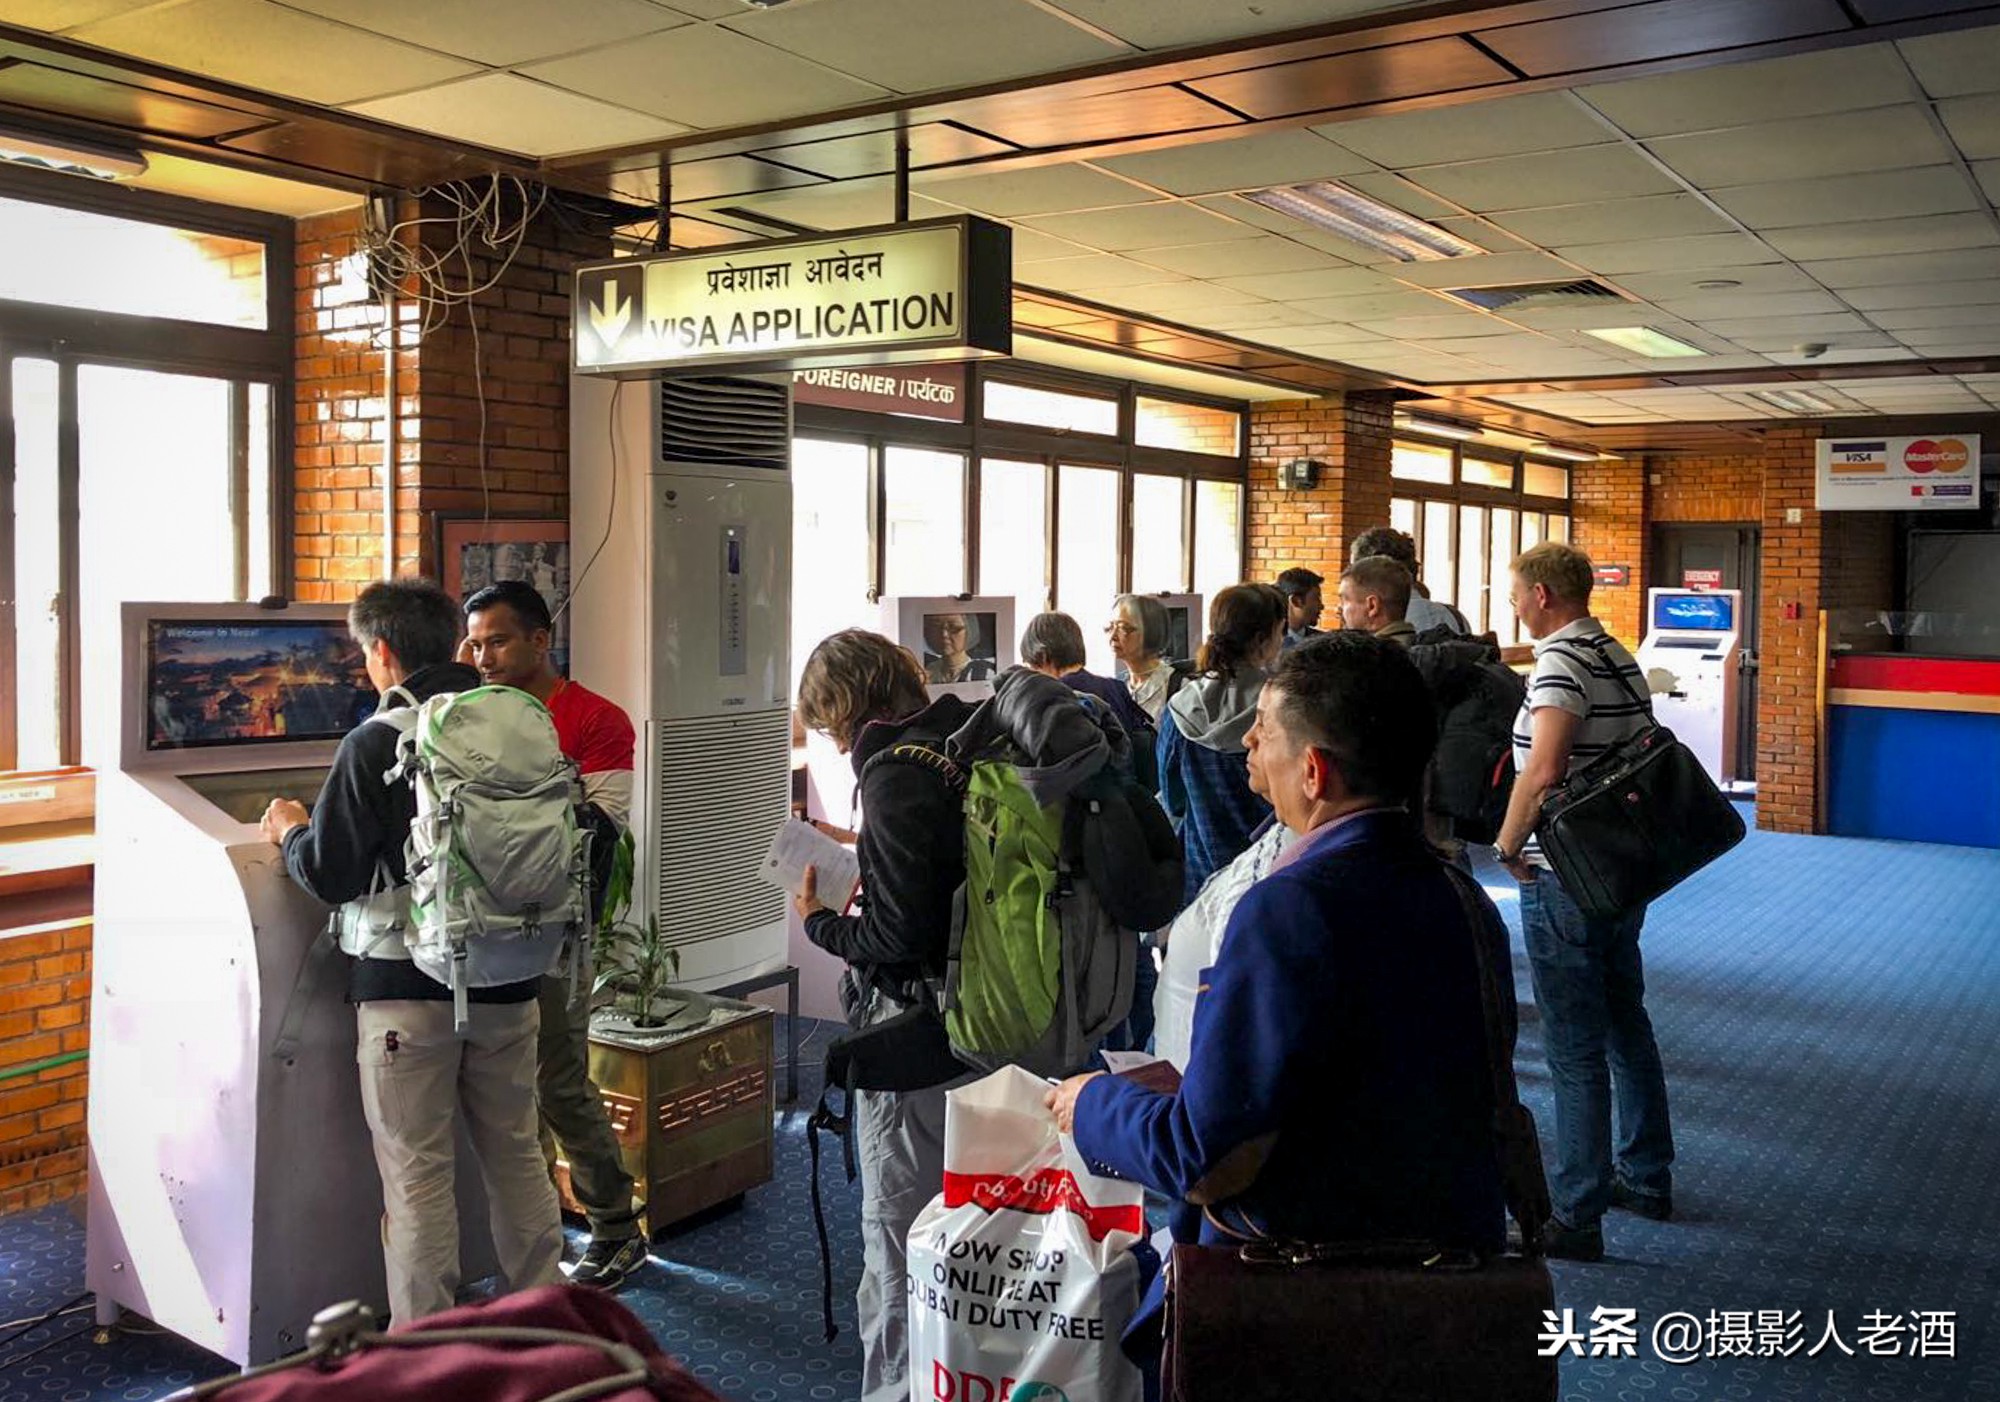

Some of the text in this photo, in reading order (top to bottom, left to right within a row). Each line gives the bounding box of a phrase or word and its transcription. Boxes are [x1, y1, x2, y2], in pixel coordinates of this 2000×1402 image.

[805, 249, 884, 286] आवेदन
[649, 291, 953, 348] VISA APPLICATION
[793, 369, 895, 396] FOREIGNER
[1846, 453, 1872, 462] VISA
[1008, 1248, 1064, 1273] SHOP
[1028, 1280, 1061, 1304] AT
[968, 1301, 1043, 1332] DUTY
[1048, 1311, 1105, 1341] FREE
